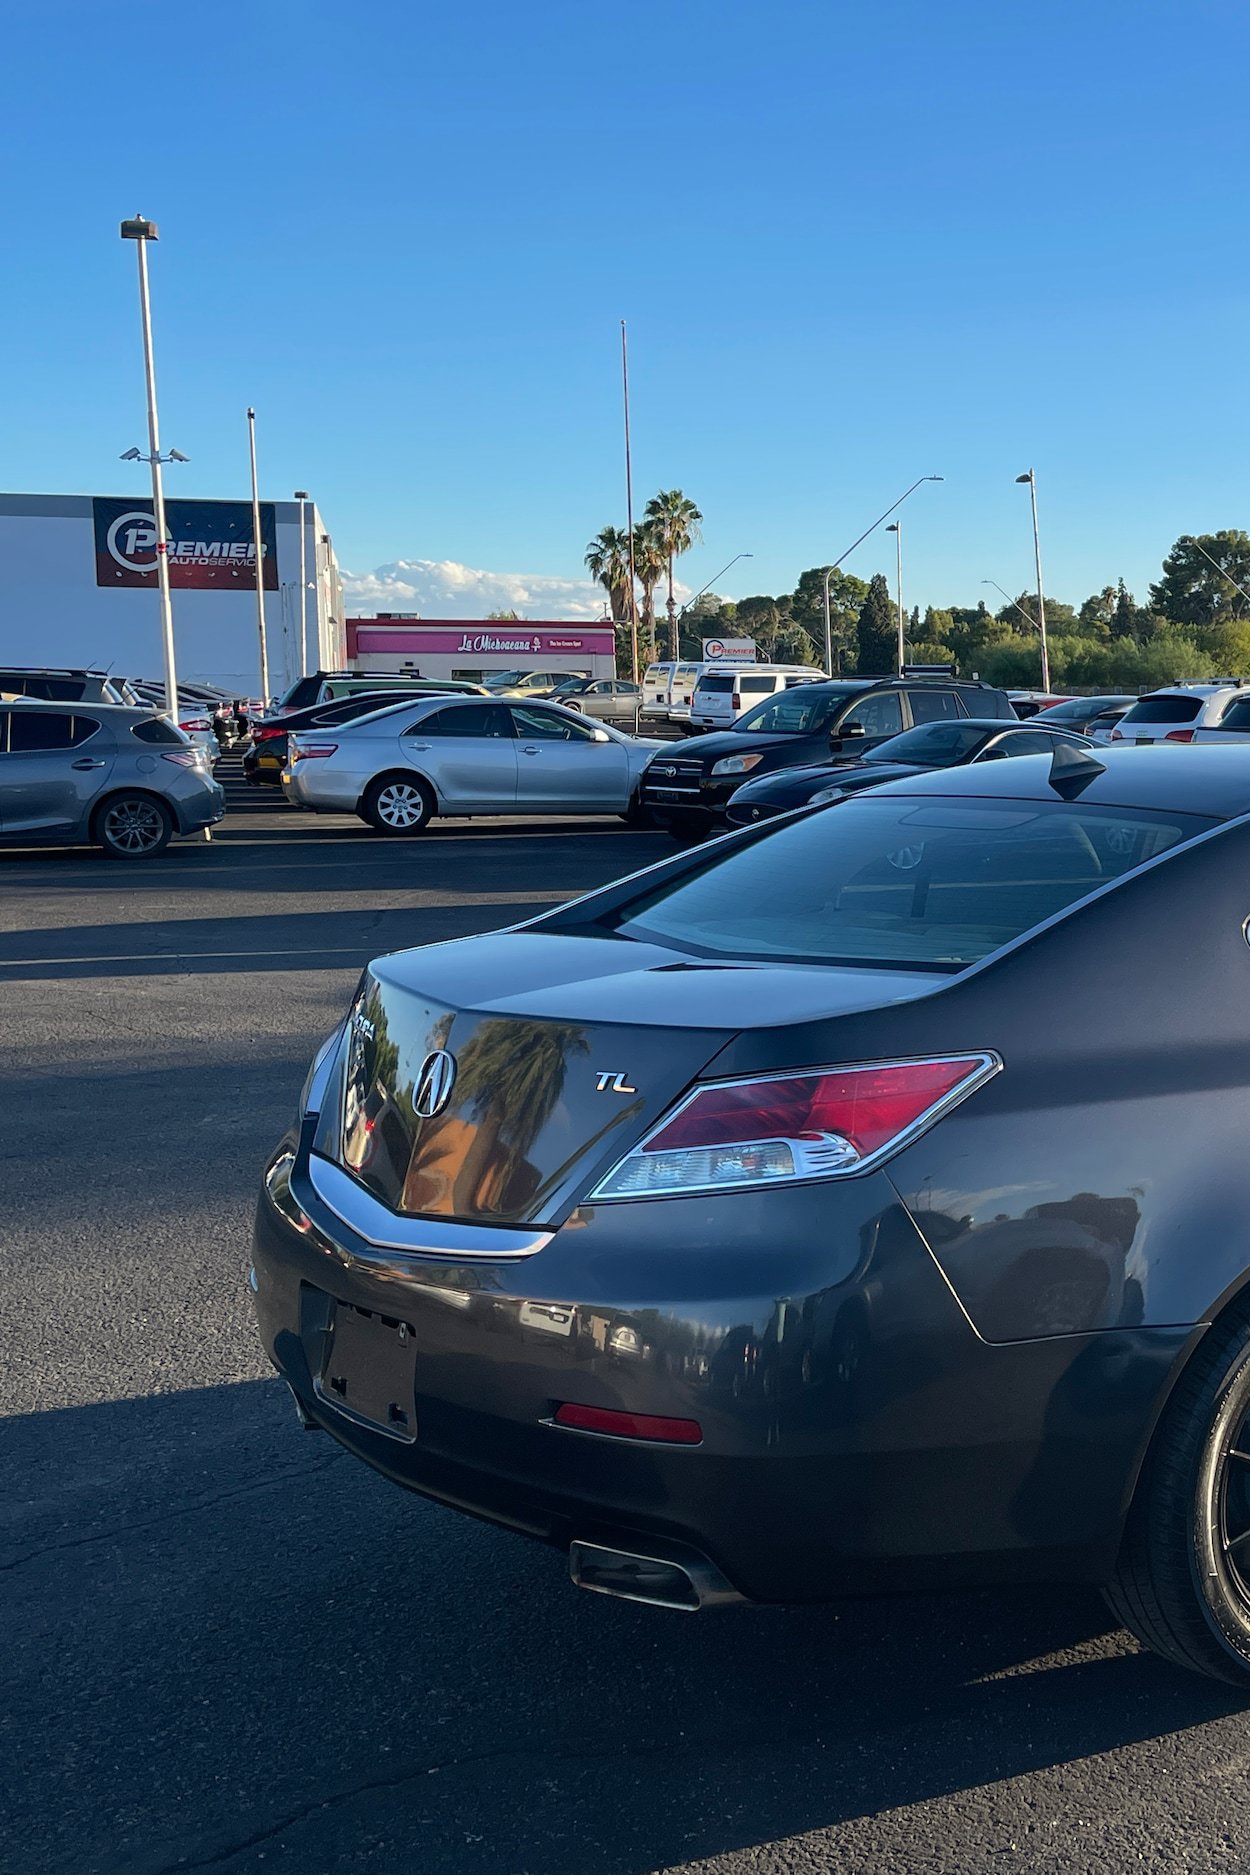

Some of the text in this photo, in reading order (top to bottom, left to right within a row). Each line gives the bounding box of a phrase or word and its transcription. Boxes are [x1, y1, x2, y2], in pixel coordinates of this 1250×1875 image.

[458, 634, 473, 651] La
[712, 644, 755, 655] PREMIER
[596, 1071, 636, 1093] TL
